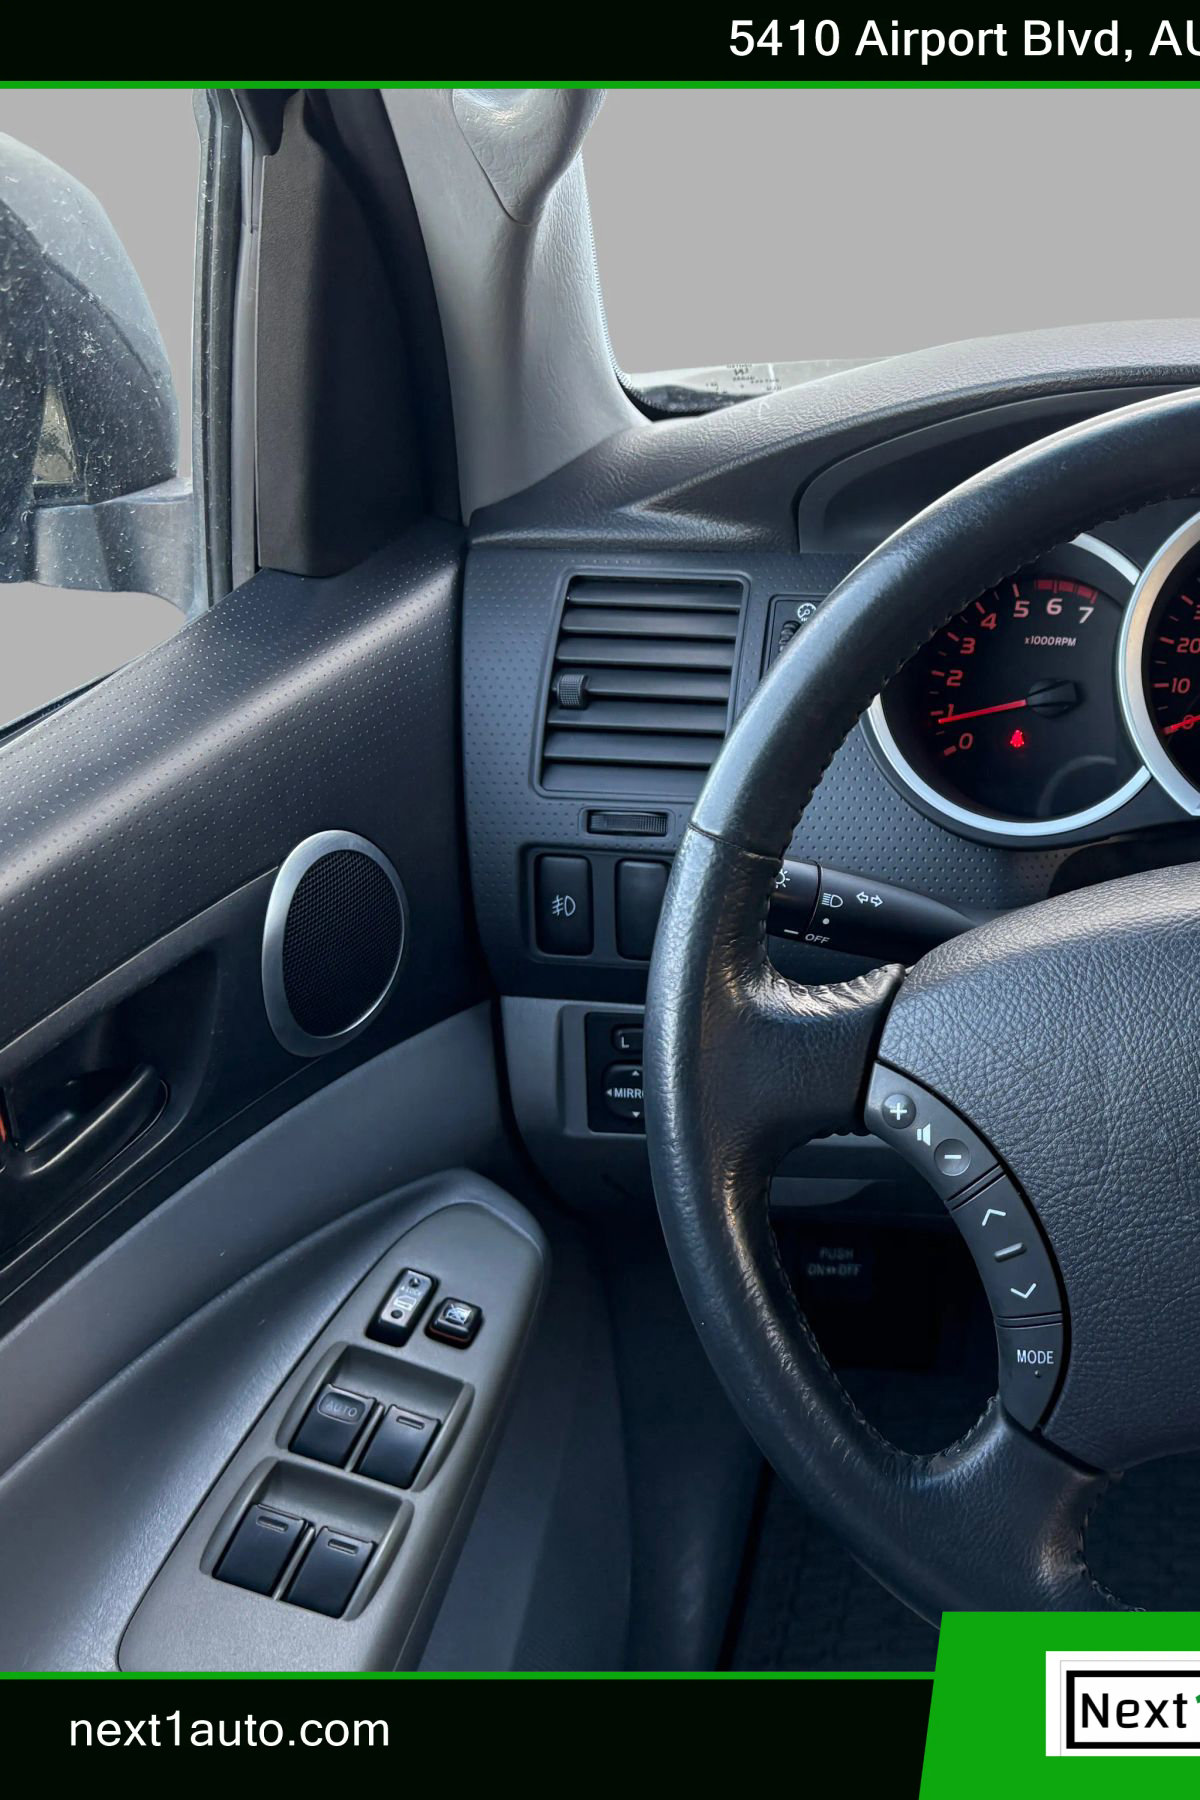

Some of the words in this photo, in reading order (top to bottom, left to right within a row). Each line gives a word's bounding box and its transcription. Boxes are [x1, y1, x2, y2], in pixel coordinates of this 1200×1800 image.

[1013, 601, 1030, 618] 5
[1046, 598, 1062, 615] 6
[1079, 606, 1094, 624] 7
[981, 613, 997, 630] 4
[960, 637, 976, 654] 3
[946, 669, 963, 686] 2
[1171, 677, 1191, 694] 10
[948, 704, 955, 719] 1
[959, 732, 974, 749] 0
[805, 933, 830, 945] OFF
[621, 1036, 630, 1049] L
[613, 1087, 644, 1099] MIRR
[806, 1262, 825, 1277] ON
[1017, 1349, 1054, 1365] MODE
[325, 1400, 358, 1417] AUTO
